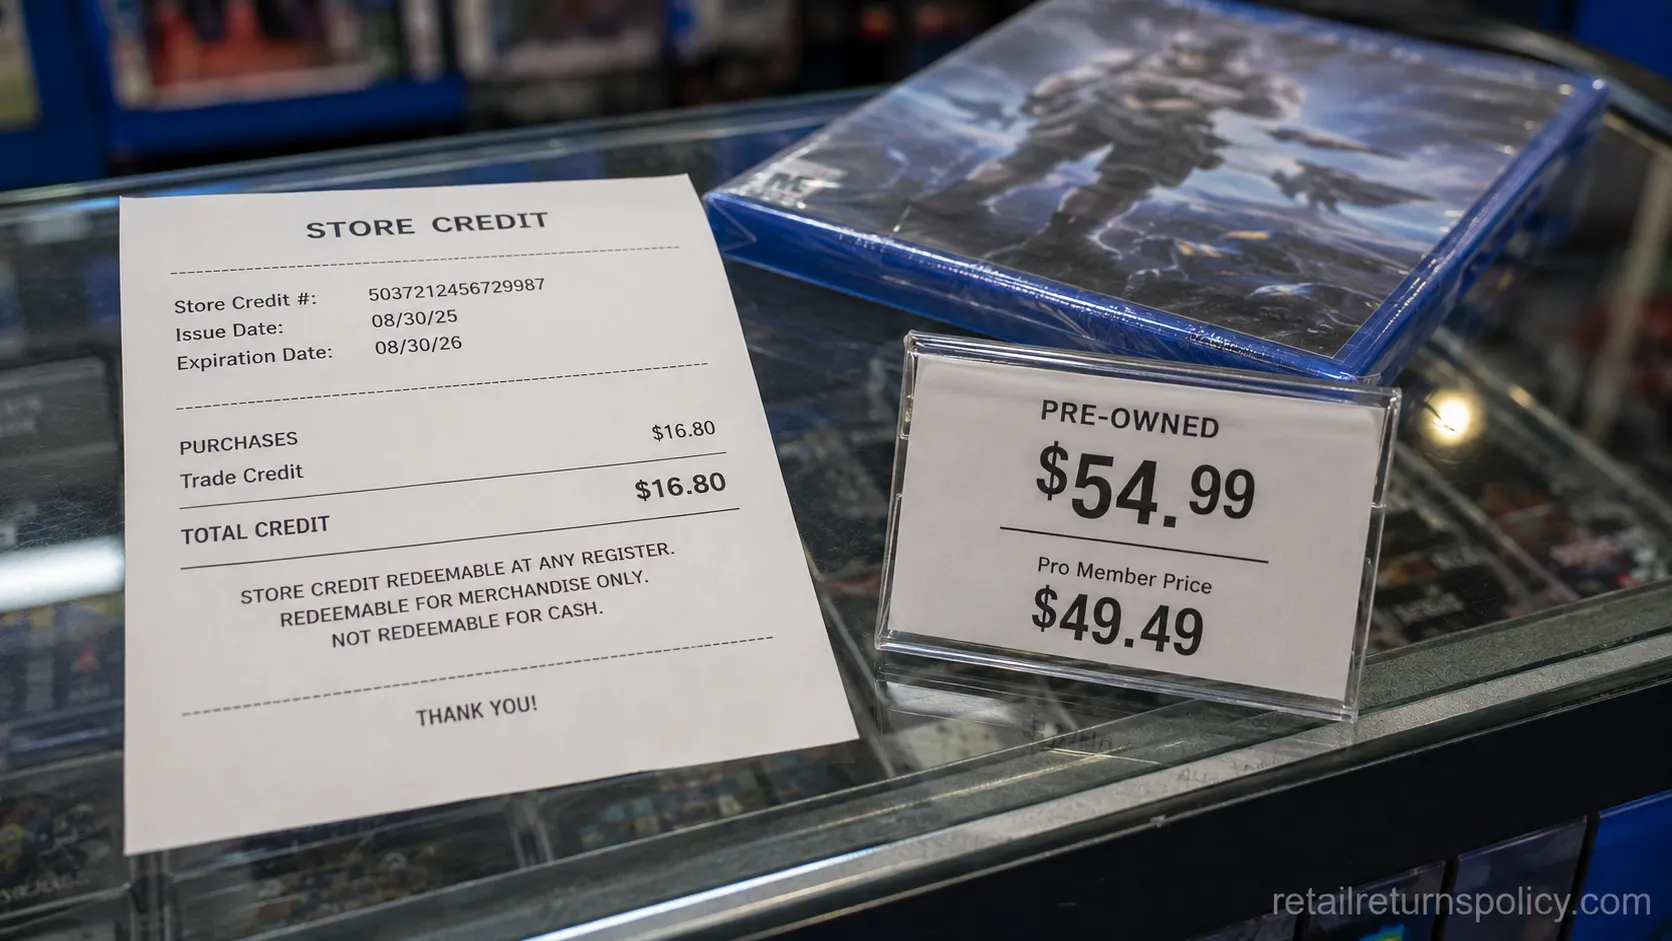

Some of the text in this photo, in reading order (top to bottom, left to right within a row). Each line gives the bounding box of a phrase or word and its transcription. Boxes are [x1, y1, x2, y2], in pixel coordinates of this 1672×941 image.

[306, 211, 549, 239] STORE CREDIT
[174, 277, 545, 315] Store Credit #: 5037212456729987
[175, 308, 458, 343] Issue Date: 08/30/25
[177, 335, 463, 373] Expiration Date: 08/30/26
[1040, 399, 1220, 439] PRE-OWNED
[179, 431, 299, 456] PURCHASES
[179, 420, 716, 489] Trade Credit $16.80
[1035, 440, 1256, 529] $54.99
[180, 471, 727, 545] TOTAL CREDIT $16.80
[240, 542, 675, 605] STORE CREDIT REDEEMABLE AT ANY REGISTER.
[1037, 556, 1213, 595] Pro Member Price
[280, 569, 649, 628] REDEEMABLE FOR MERCHANDISE ONLY.
[331, 600, 604, 649] NOT REDEEMABLE FOR CASH.
[1031, 584, 1204, 657] $49.49
[415, 694, 538, 727] THANK YOU!
